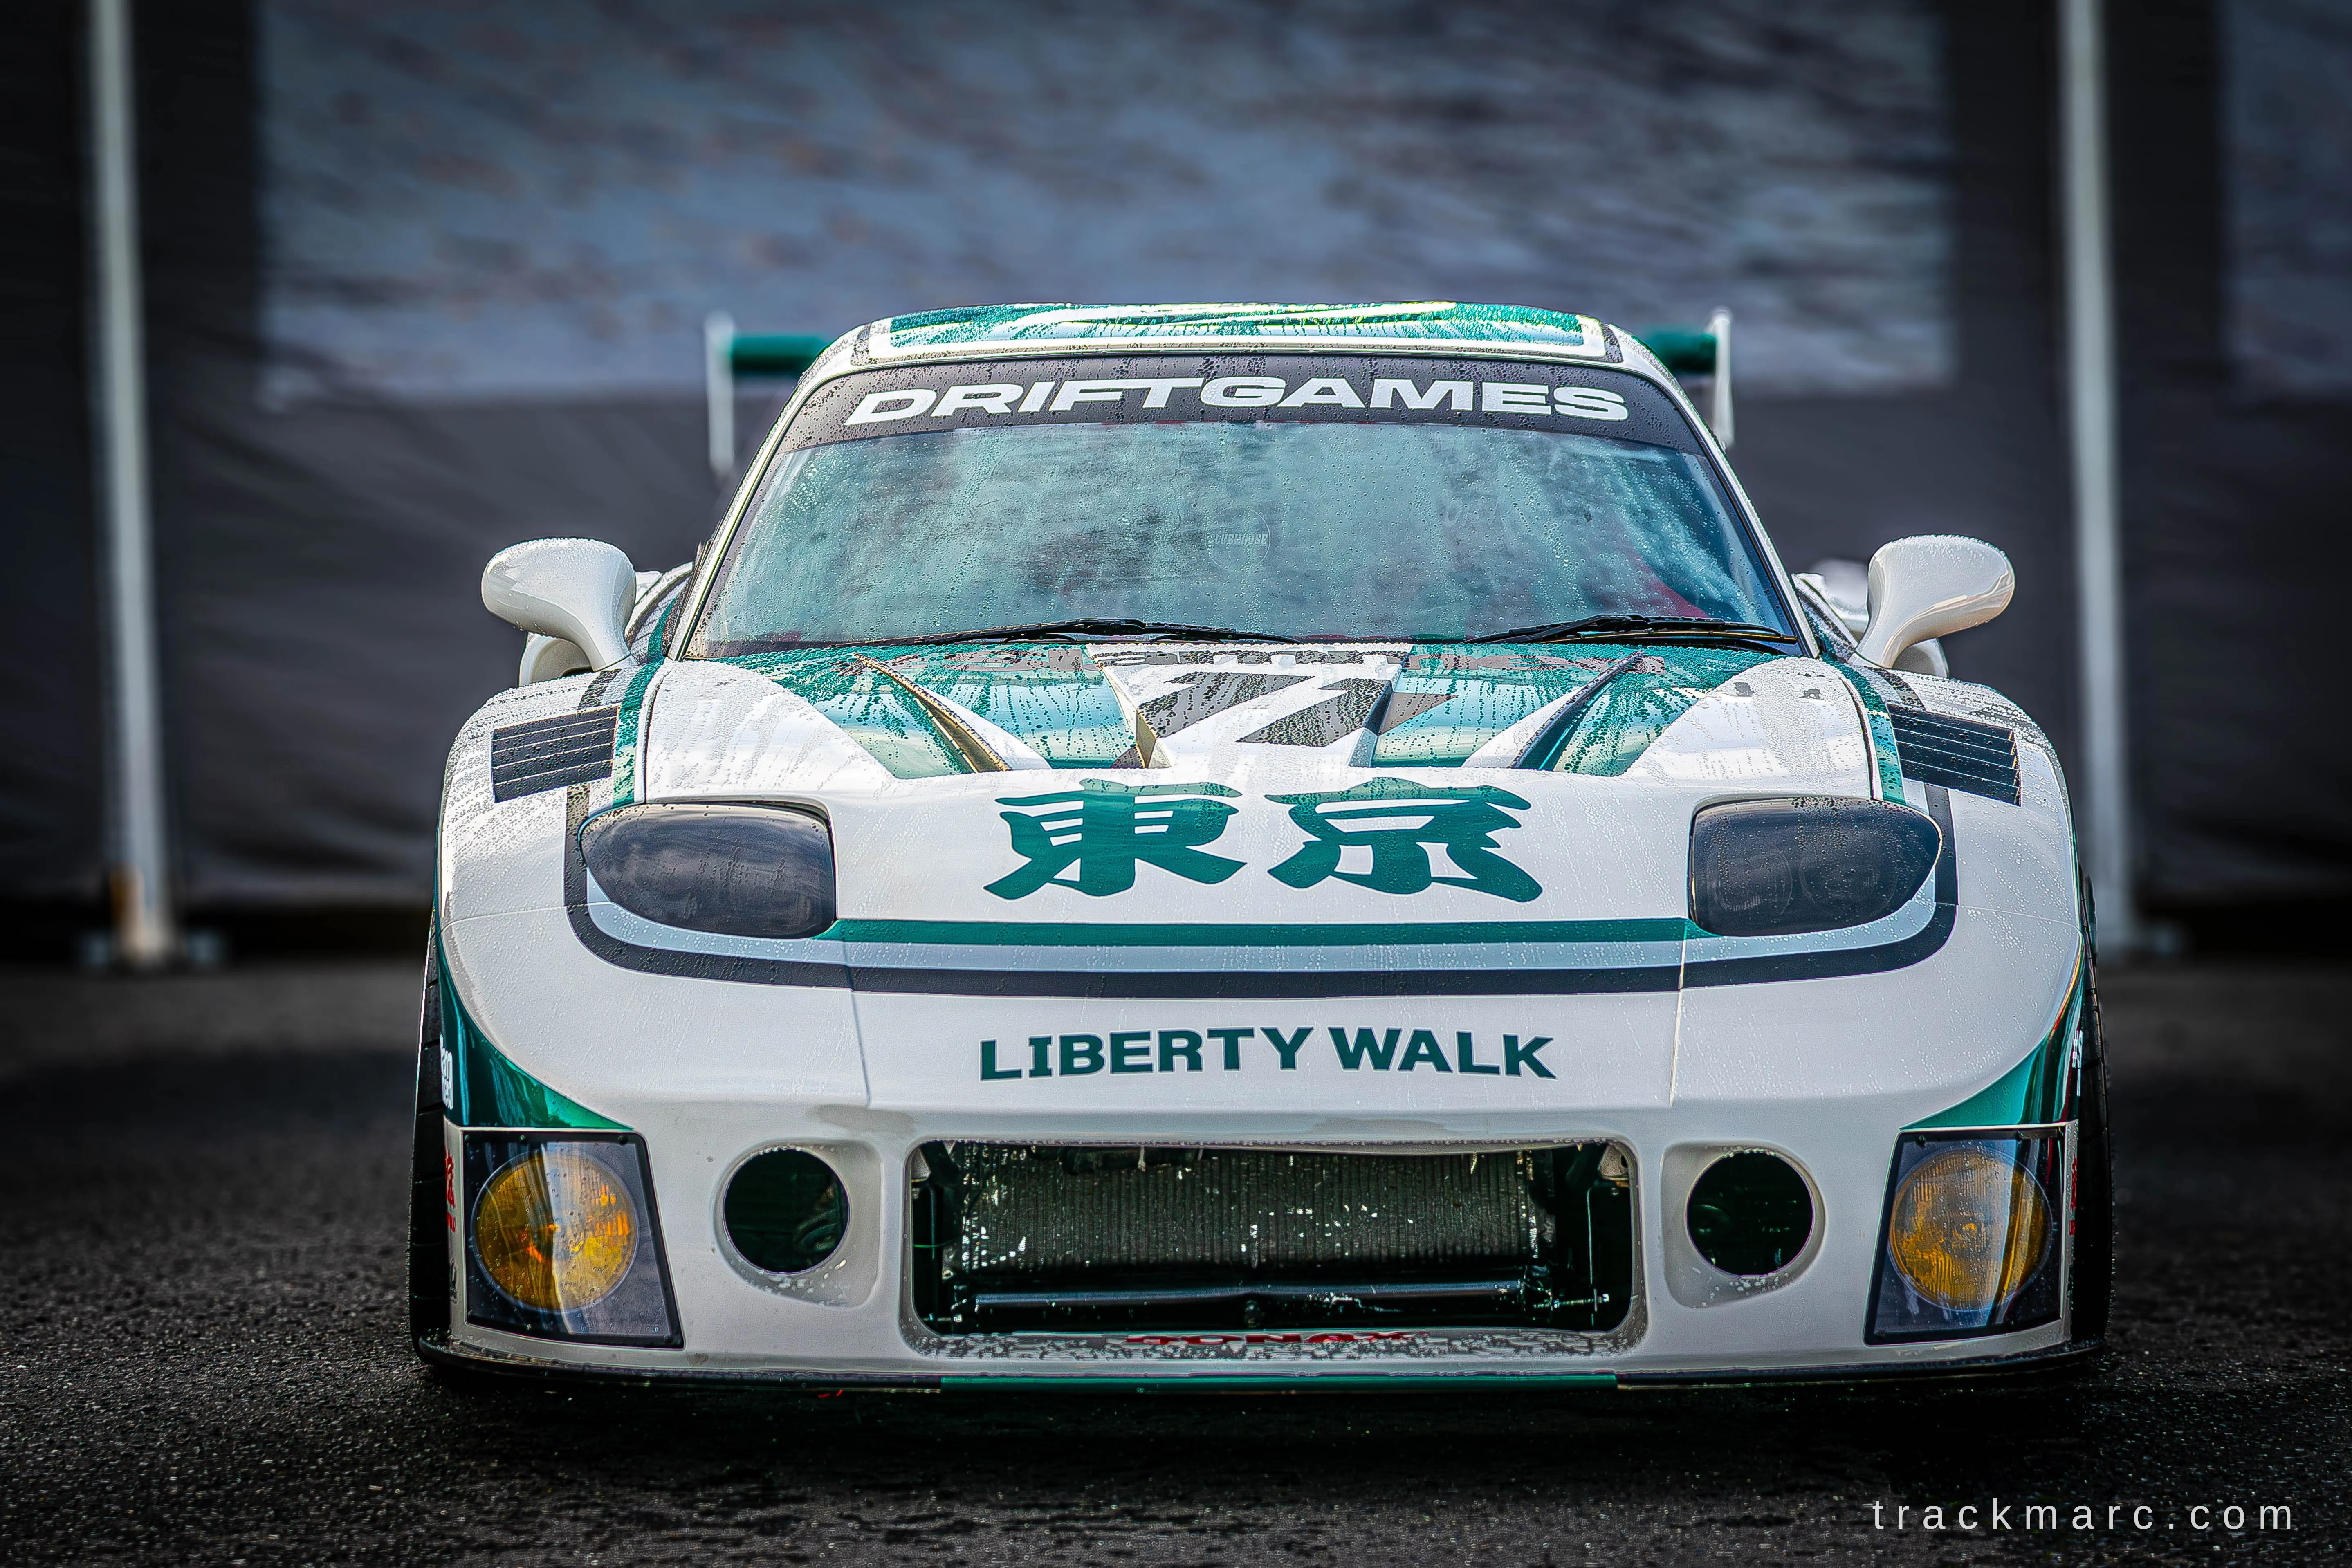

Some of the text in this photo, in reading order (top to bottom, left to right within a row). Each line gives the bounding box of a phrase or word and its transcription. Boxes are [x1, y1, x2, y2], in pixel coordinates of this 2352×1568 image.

[843, 377, 1629, 426] DRIFTGAMES
[983, 776, 1543, 902] 東京
[980, 1027, 1558, 1082] LIBERTY WALK
